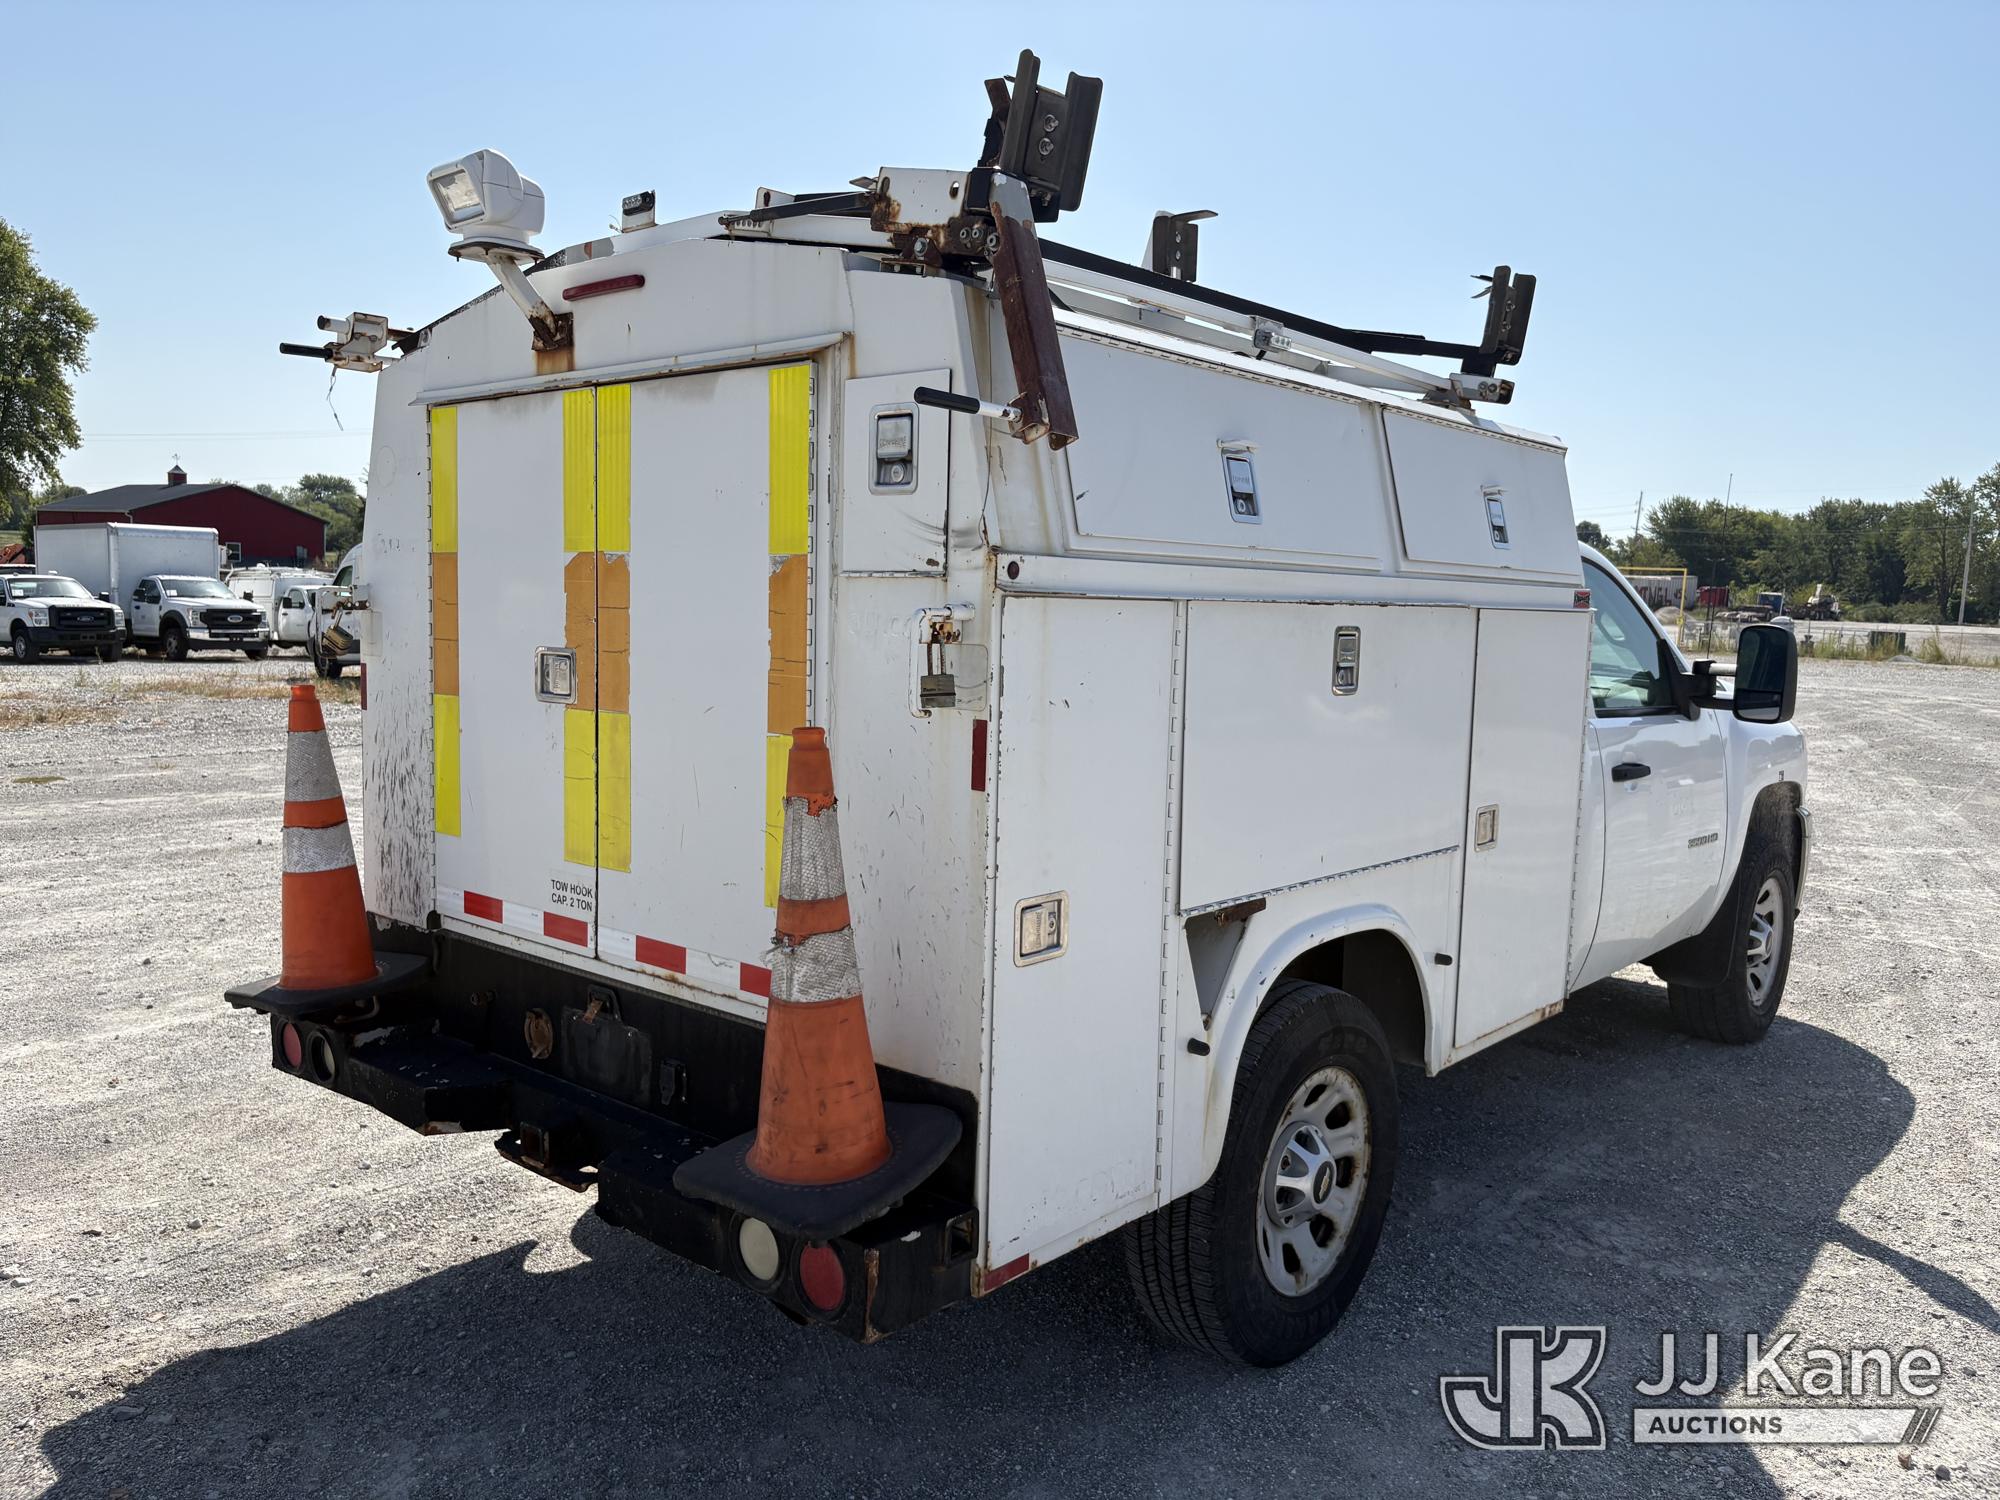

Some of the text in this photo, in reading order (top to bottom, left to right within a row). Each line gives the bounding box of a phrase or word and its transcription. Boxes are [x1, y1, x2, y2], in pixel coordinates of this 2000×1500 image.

[551, 879, 593, 898] TOW HOOK
[552, 893, 593, 911] CAP. 2 TON
